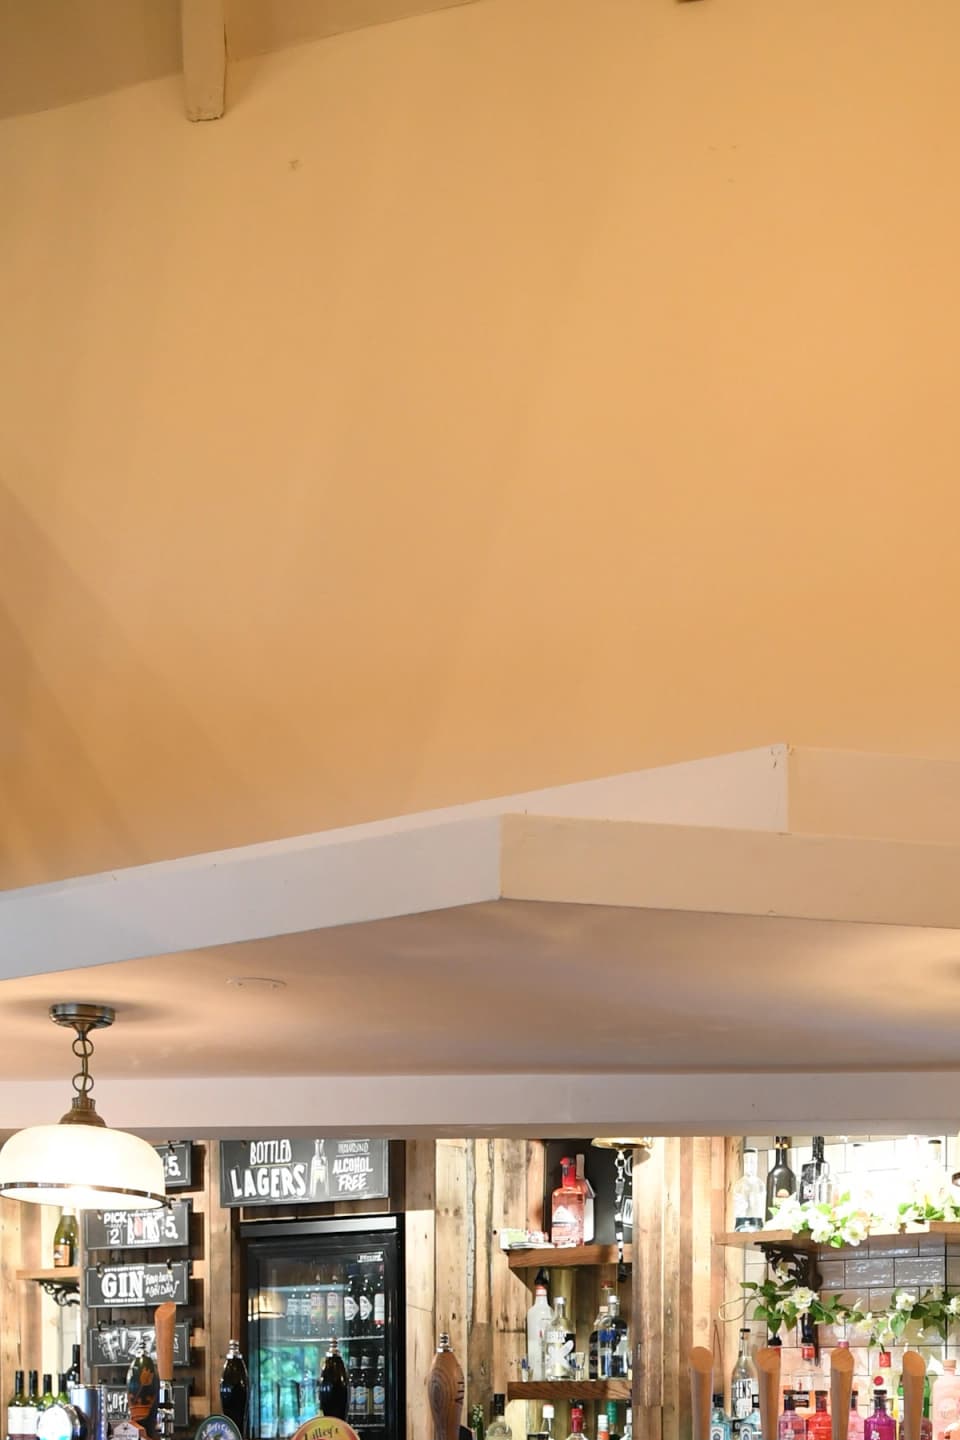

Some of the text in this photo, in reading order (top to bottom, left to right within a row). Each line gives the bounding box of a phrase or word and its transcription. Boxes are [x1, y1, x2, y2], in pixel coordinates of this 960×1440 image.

[250, 1139, 292, 1165] BOTTLED
[332, 1156, 374, 1174] ALCOHOL
[230, 1164, 307, 1198] LAGERS
[338, 1173, 367, 1192] FREE
[104, 1212, 127, 1225] PICK
[110, 1229, 121, 1244] 2
[101, 1271, 144, 1298] GIN
